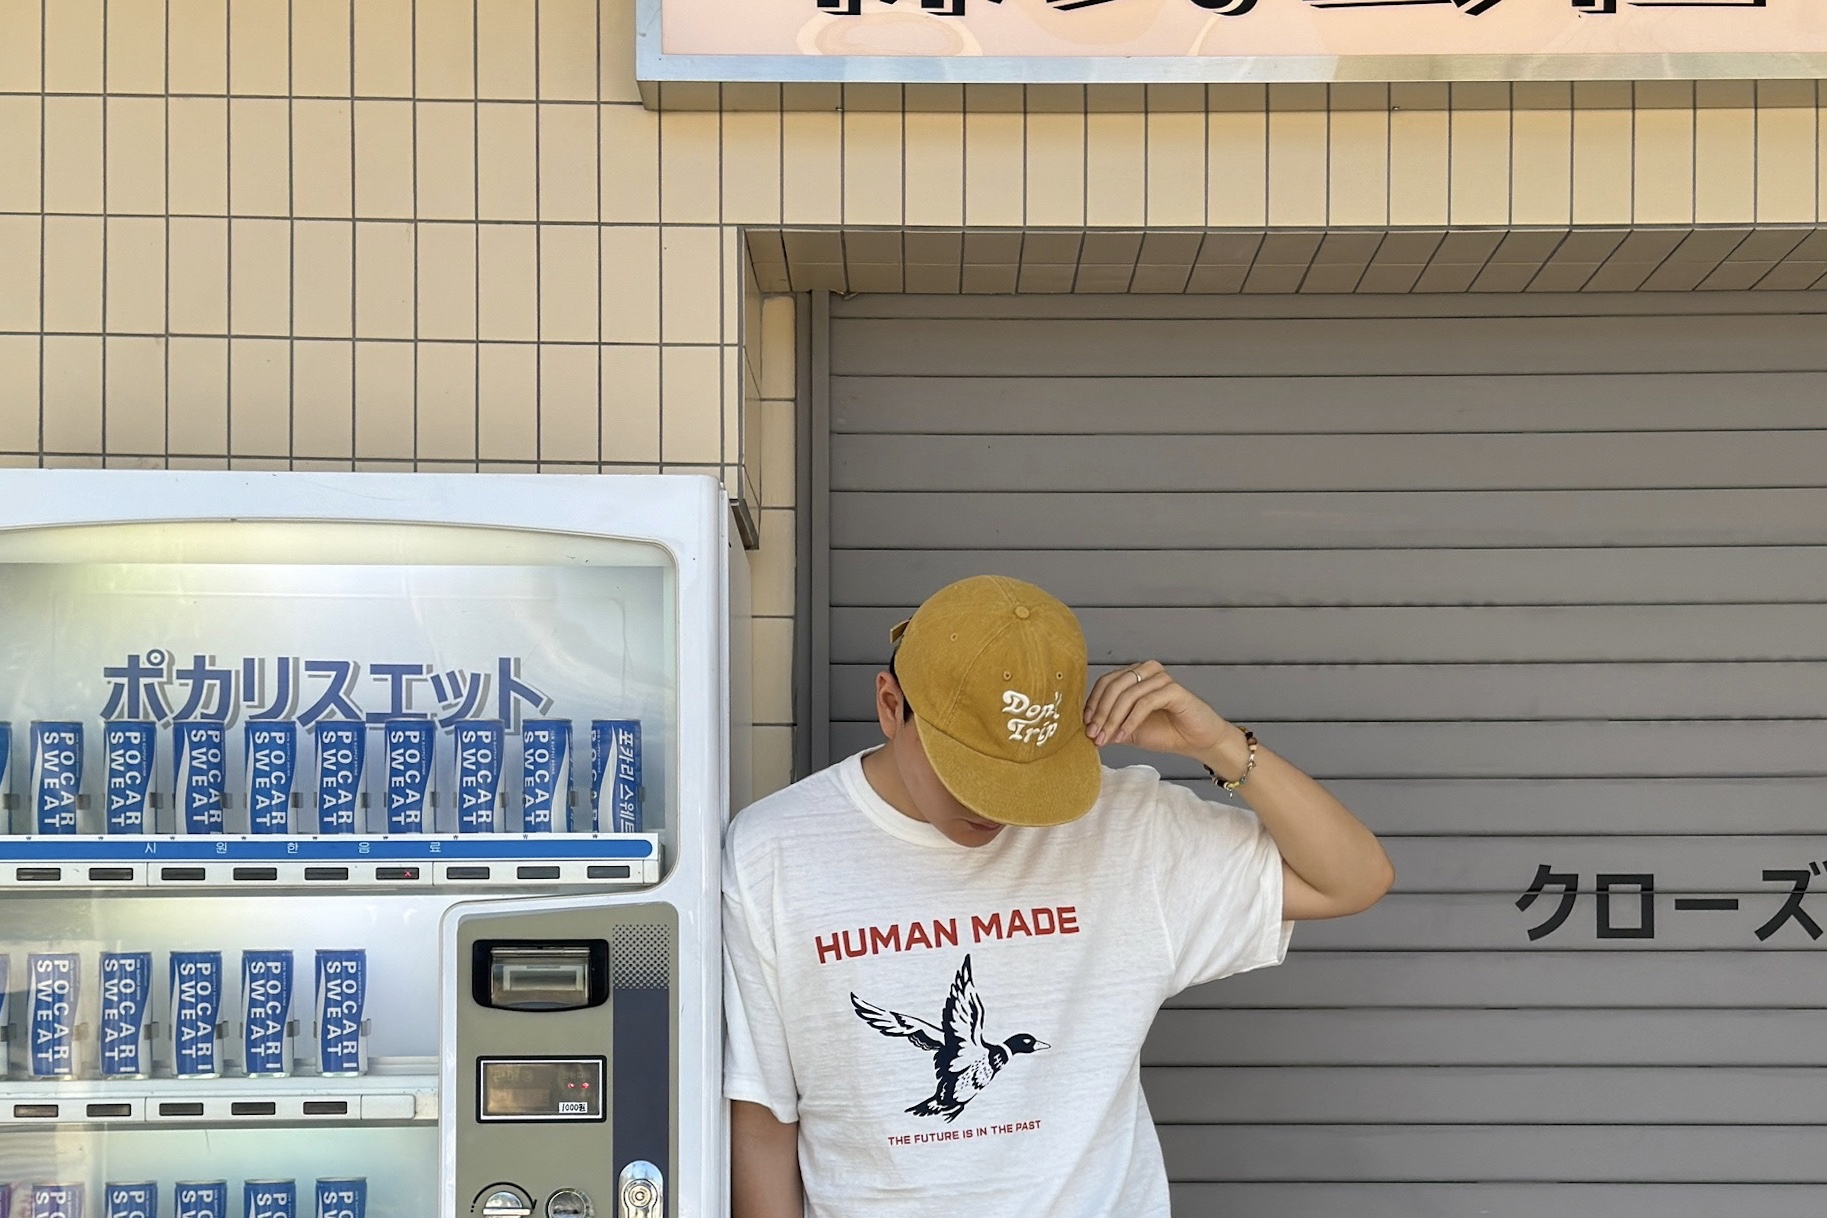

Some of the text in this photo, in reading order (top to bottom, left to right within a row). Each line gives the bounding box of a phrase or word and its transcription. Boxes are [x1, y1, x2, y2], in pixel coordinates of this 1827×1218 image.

[44, 732, 59, 828] SWEAT
[60, 732, 75, 826] POCAR
[111, 732, 125, 827] SWEAT
[125, 731, 141, 825] POCAR
[190, 729, 208, 825] SWEAT
[255, 731, 270, 827] SWEAT
[270, 731, 286, 825] POCAR
[322, 731, 337, 826] SWEAT
[337, 731, 352, 824] POCAR
[391, 731, 405, 826] SWEAT
[405, 730, 420, 824] POCAR
[462, 731, 476, 826] SWEAT
[477, 730, 492, 824] POCAR
[524, 731, 535, 826] SWEAT
[1007, 718, 1058, 747] Trip
[535, 730, 549, 833] POCAR
[815, 906, 1080, 964] HUMAN MADE
[1515, 861, 1827, 942] クローズ
[37, 960, 52, 1062] SWEAT
[54, 959, 69, 1073] POCARI
[104, 959, 118, 1060] SWEAT
[119, 959, 135, 1072] POCARI
[180, 963, 195, 1058] SWEAT
[196, 963, 212, 1069] POCARI
[250, 961, 265, 1056] SWEAT
[266, 961, 281, 1068] POCARI
[326, 961, 341, 1056] SWEAT
[342, 961, 357, 1068] POCARI
[887, 1120, 1041, 1146] THE FUTURE IS IN THE PAST
